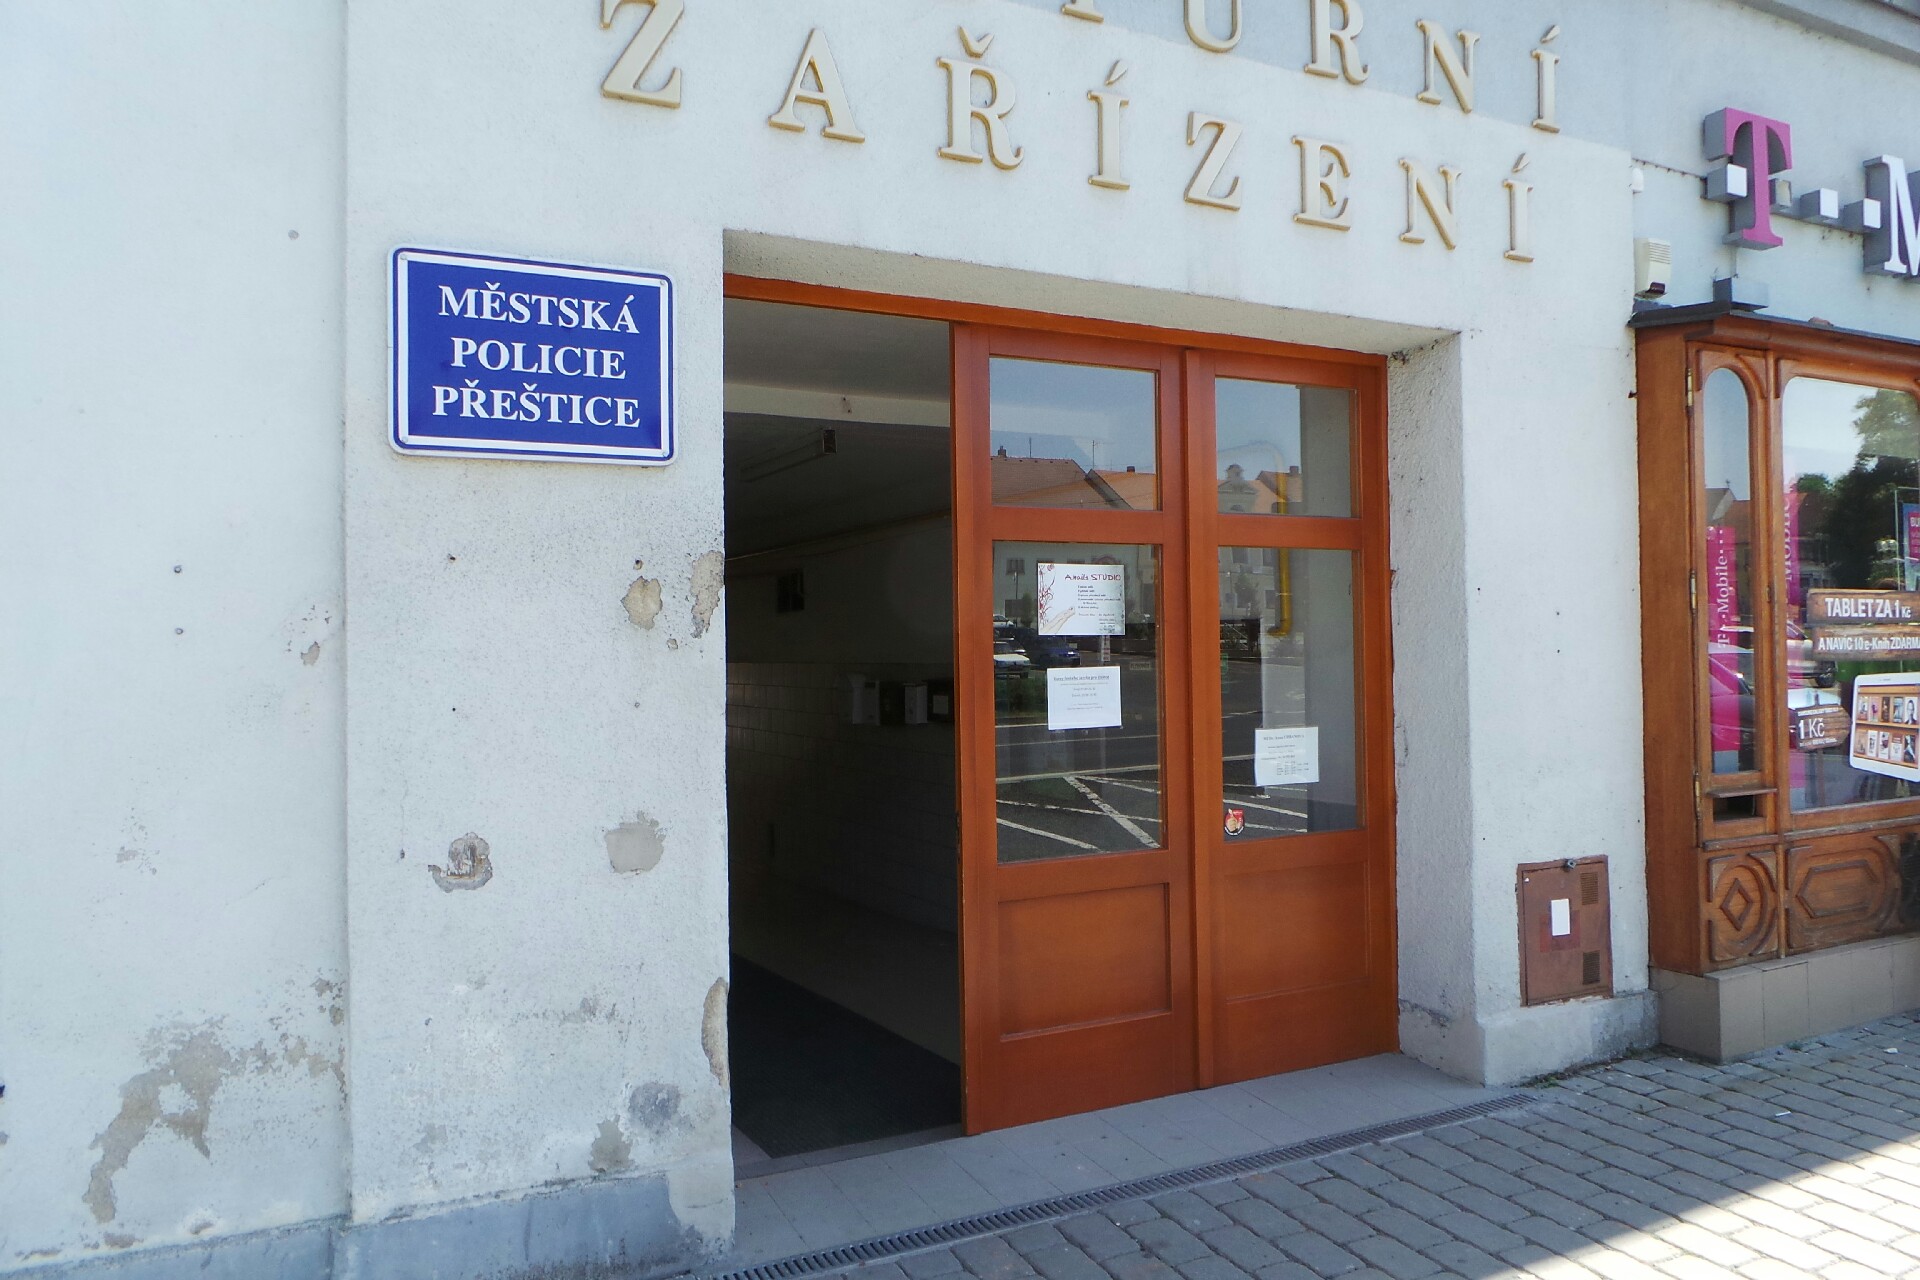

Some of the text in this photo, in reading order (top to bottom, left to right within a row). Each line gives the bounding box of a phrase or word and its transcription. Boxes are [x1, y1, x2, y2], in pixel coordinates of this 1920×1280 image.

[590, 0, 1535, 262] ZAŘÍZENÍ
[438, 281, 640, 334] MĚSTSKÁ
[450, 336, 626, 380] POLICIE
[432, 378, 641, 428] PŘEŠTICE
[1090, 573, 1121, 581] STUDIO
[1825, 597, 1874, 617] TABLET
[1875, 598, 1893, 618] ZA
[1894, 599, 1900, 618] 1
[1818, 637, 1826, 650] A
[1854, 637, 1864, 650] 10
[1798, 717, 1825, 739] 1 Kč
